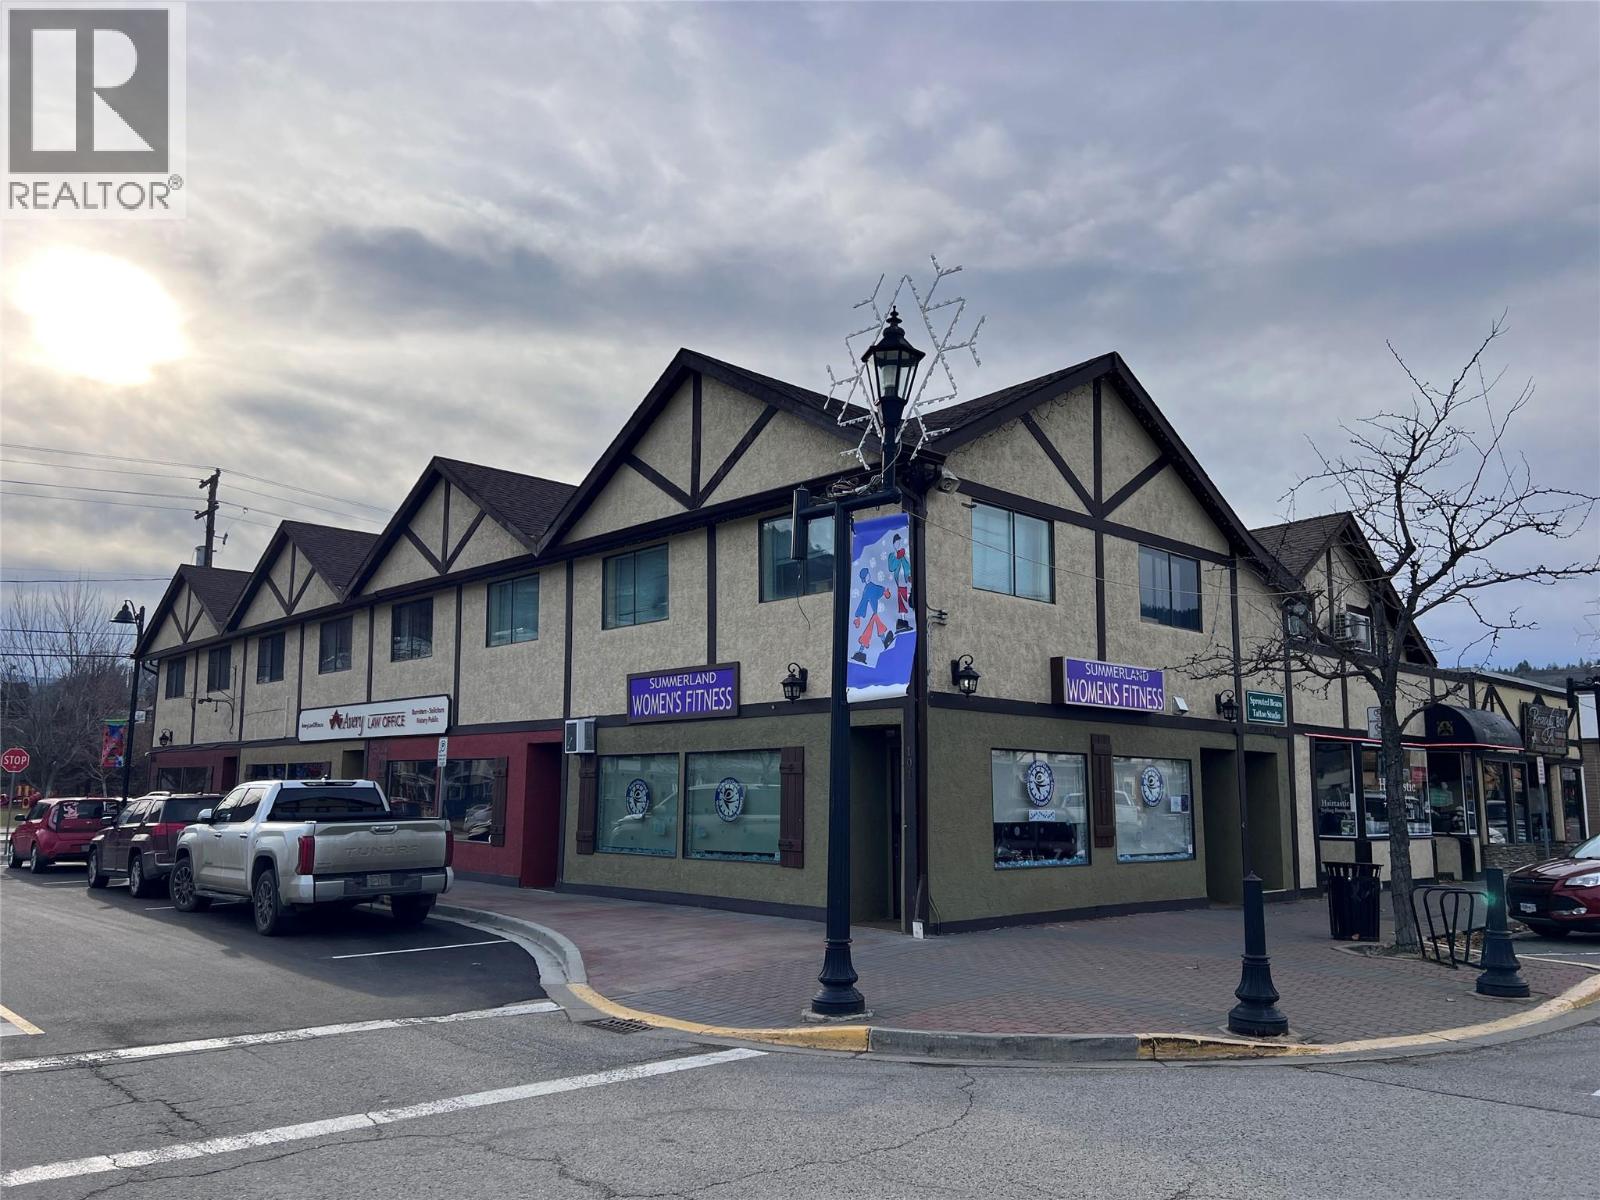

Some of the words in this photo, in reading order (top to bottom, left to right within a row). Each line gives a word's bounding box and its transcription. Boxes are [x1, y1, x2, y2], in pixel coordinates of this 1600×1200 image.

[649, 672, 717, 689] SUMMERLAND
[1085, 662, 1149, 682] SUMMERLAND
[632, 691, 682, 717] WOMEN'S
[685, 687, 732, 712] FITNESS
[1067, 678, 1120, 706] WOMEN'S
[1122, 684, 1164, 710] FITNESS
[341, 712, 364, 736] Avery
[367, 716, 382, 729] LAW
[382, 714, 406, 729] OFFICE
[3, 755, 27, 765] STOP
